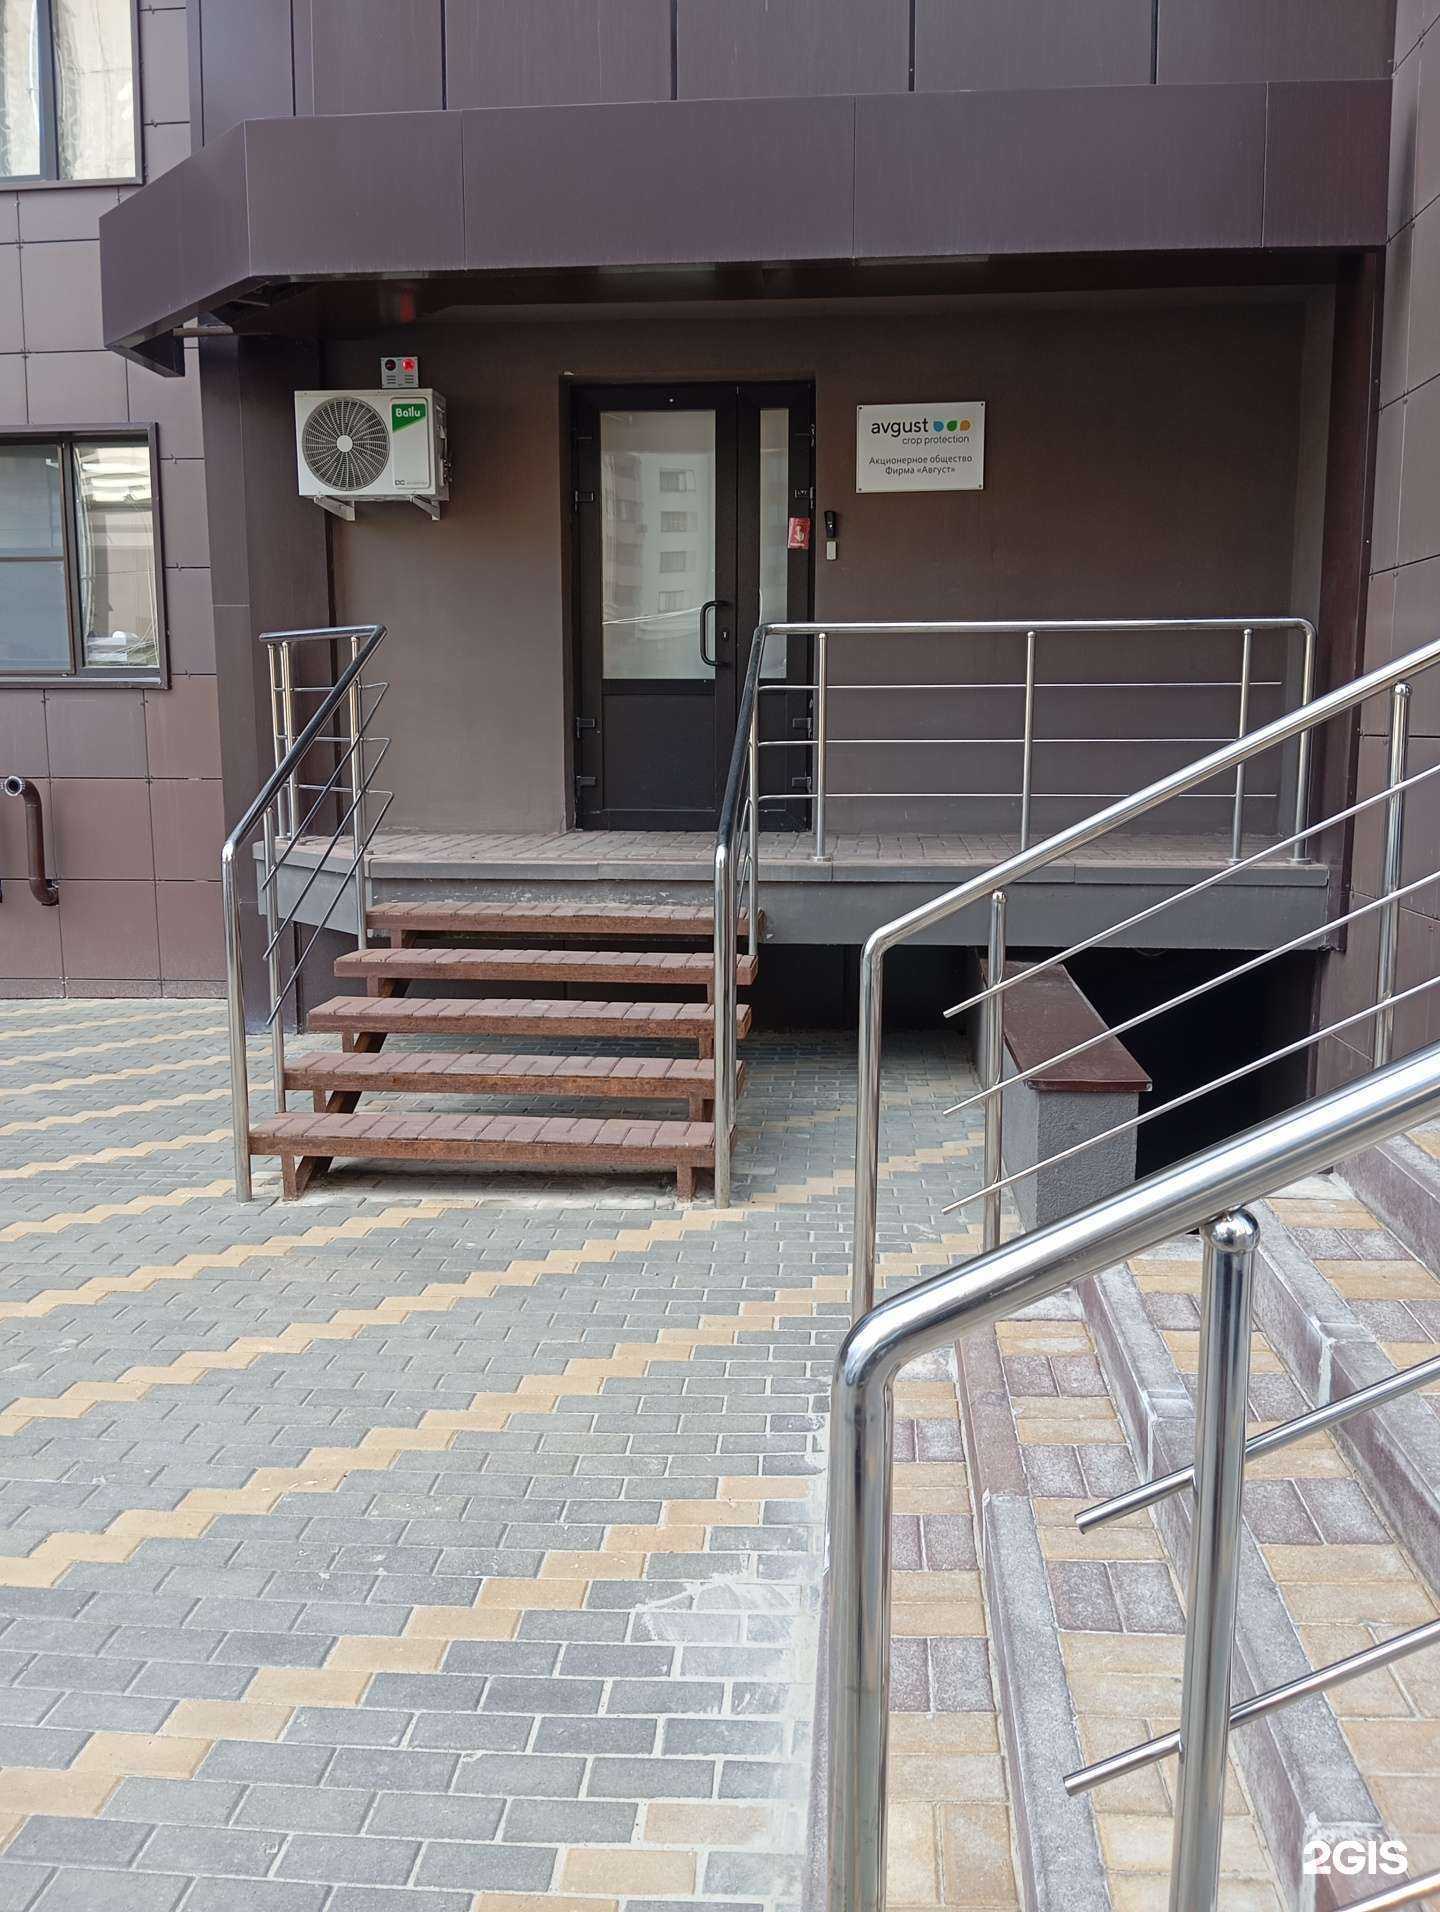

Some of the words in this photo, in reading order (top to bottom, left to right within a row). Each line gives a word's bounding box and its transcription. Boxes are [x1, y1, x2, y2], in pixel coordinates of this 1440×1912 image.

[871, 418, 929, 438] avgust
[902, 437, 923, 446] crop
[924, 435, 970, 446] protection
[868, 456, 928, 467] Акционерное
[929, 454, 973, 465] общество
[885, 466, 915, 477] Фирма
[917, 465, 956, 476] «Август»
